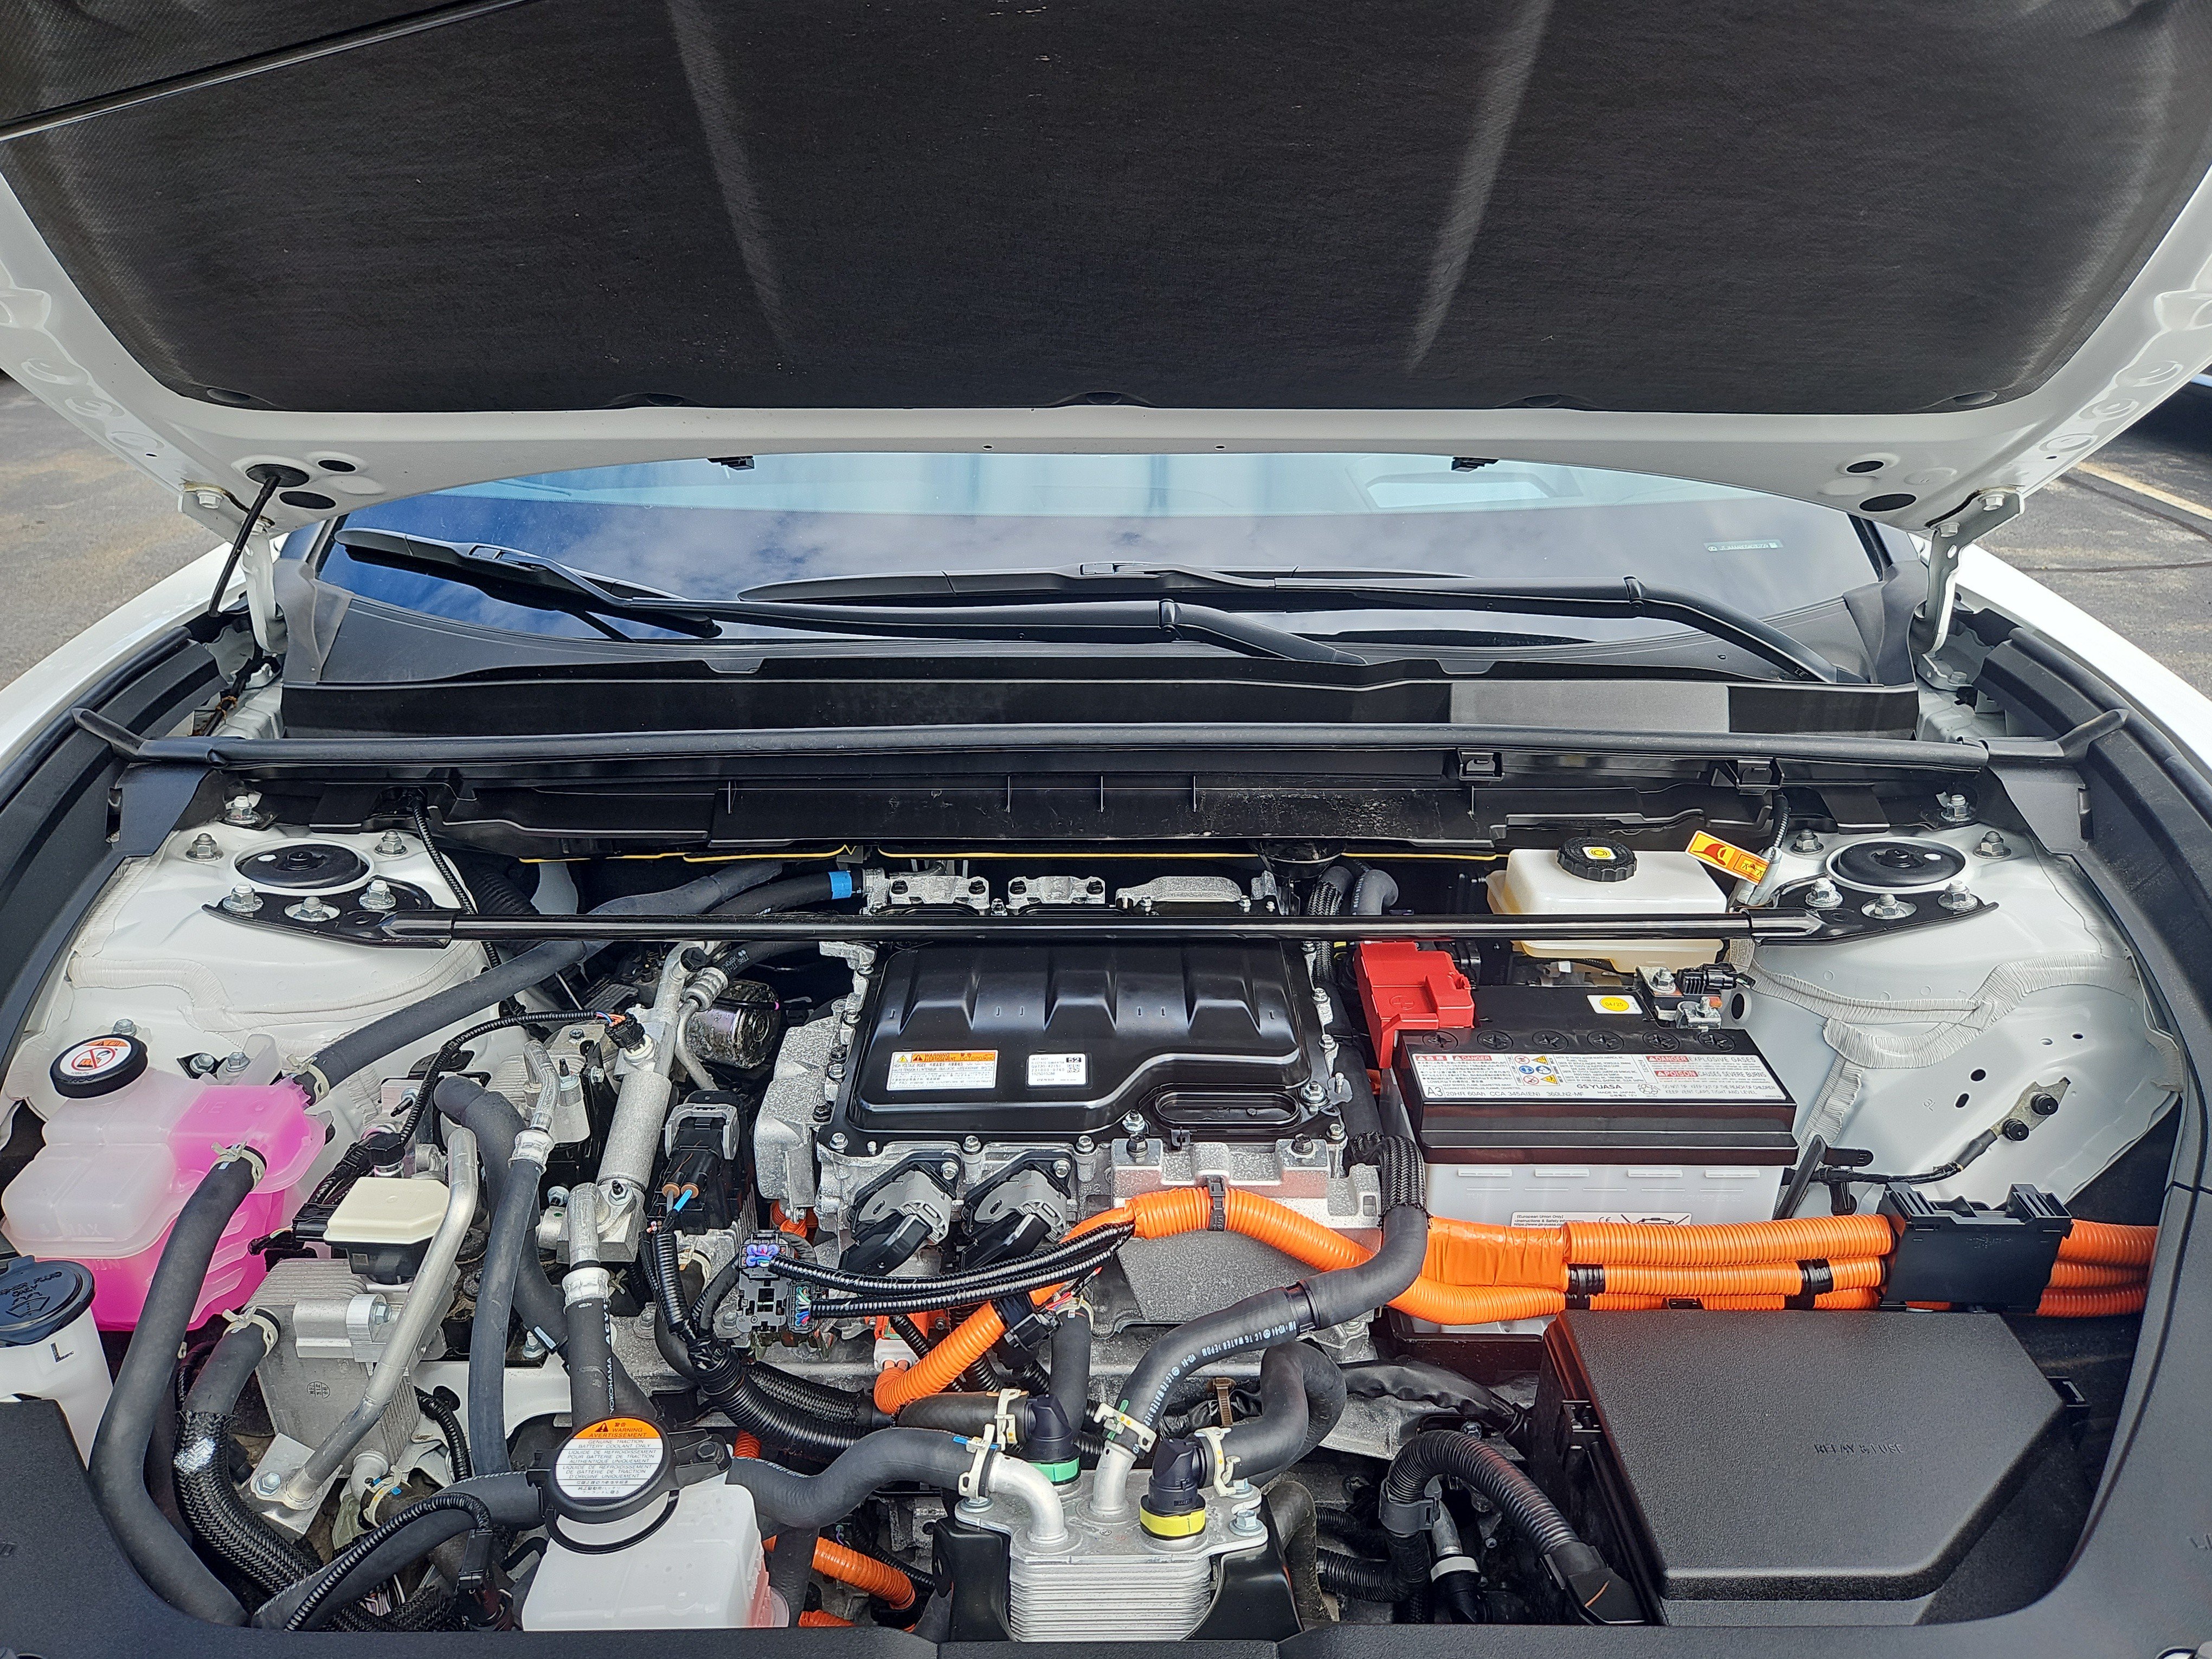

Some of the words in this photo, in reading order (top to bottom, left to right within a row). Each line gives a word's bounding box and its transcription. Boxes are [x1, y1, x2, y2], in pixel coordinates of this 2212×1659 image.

[1427, 1086, 1443, 1096] A3
[0, 1282, 28, 1295] SHER
[12, 1284, 38, 1297] ONLY
[1223, 1335, 1245, 1351] WATER
[607, 1356, 615, 1415] YOKOHAMA
[1150, 1391, 1166, 1414] WATER
[1814, 1443, 1854, 1454] RELAY
[1860, 1444, 1869, 1454] &
